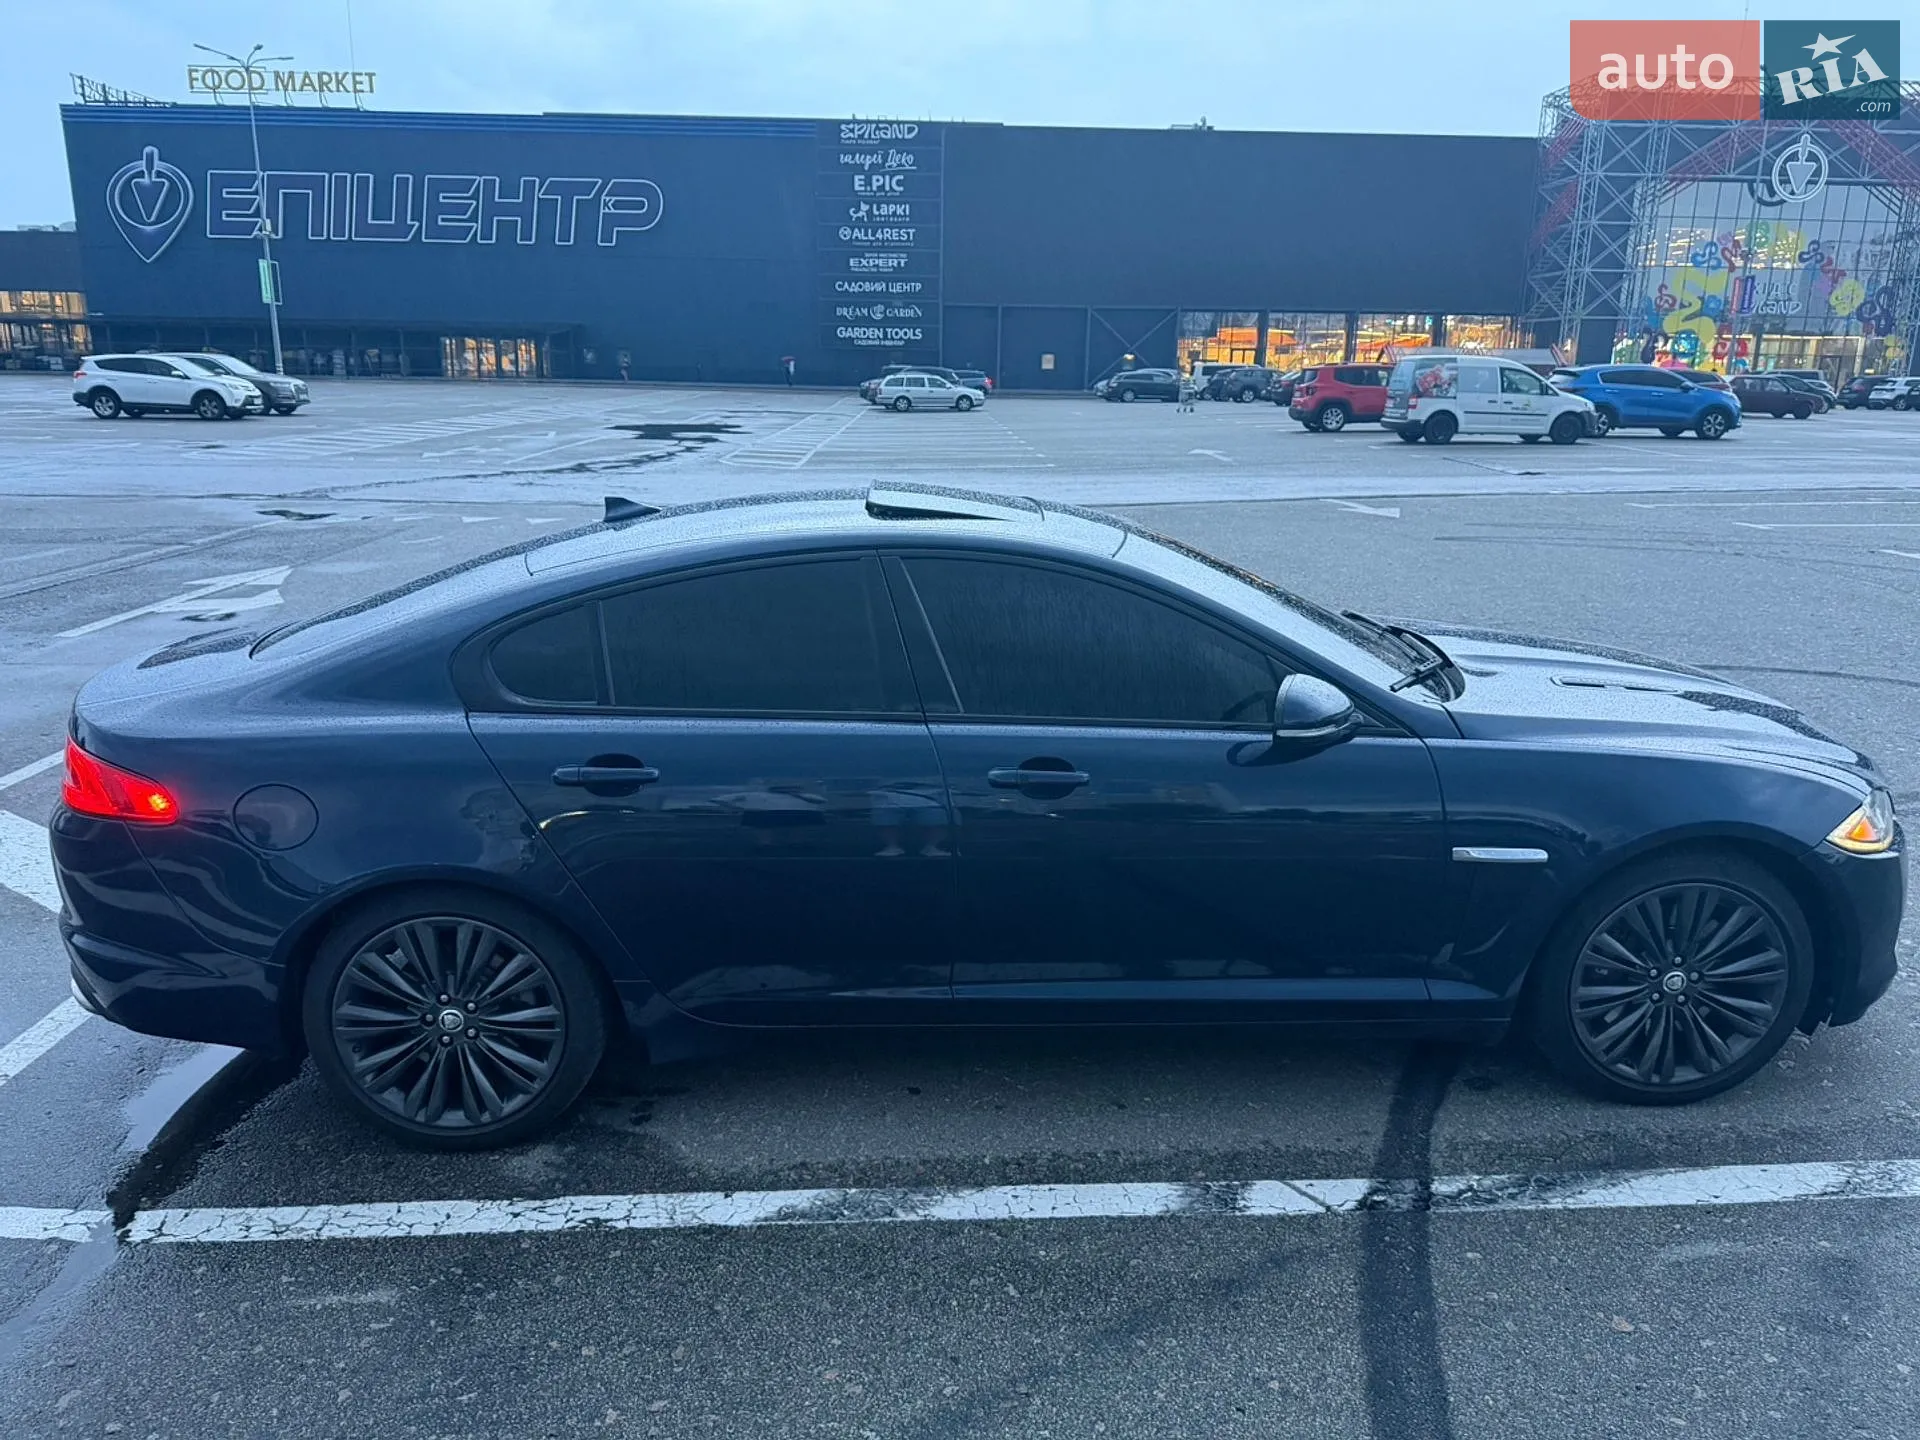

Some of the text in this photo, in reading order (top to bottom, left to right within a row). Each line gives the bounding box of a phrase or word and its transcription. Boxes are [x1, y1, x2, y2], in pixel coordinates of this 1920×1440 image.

[187, 68, 377, 93] FOOD MARKET
[853, 174, 905, 192] E.PIC
[205, 169, 664, 247] ЕПІЦЕНТР
[851, 227, 917, 241] ALL4REST
[849, 257, 909, 268] EXPERT
[834, 280, 923, 294] САДОВИЙ ЦЕНТР
[836, 305, 869, 320] DREAM
[837, 326, 922, 340] GARDEN TOOLS
